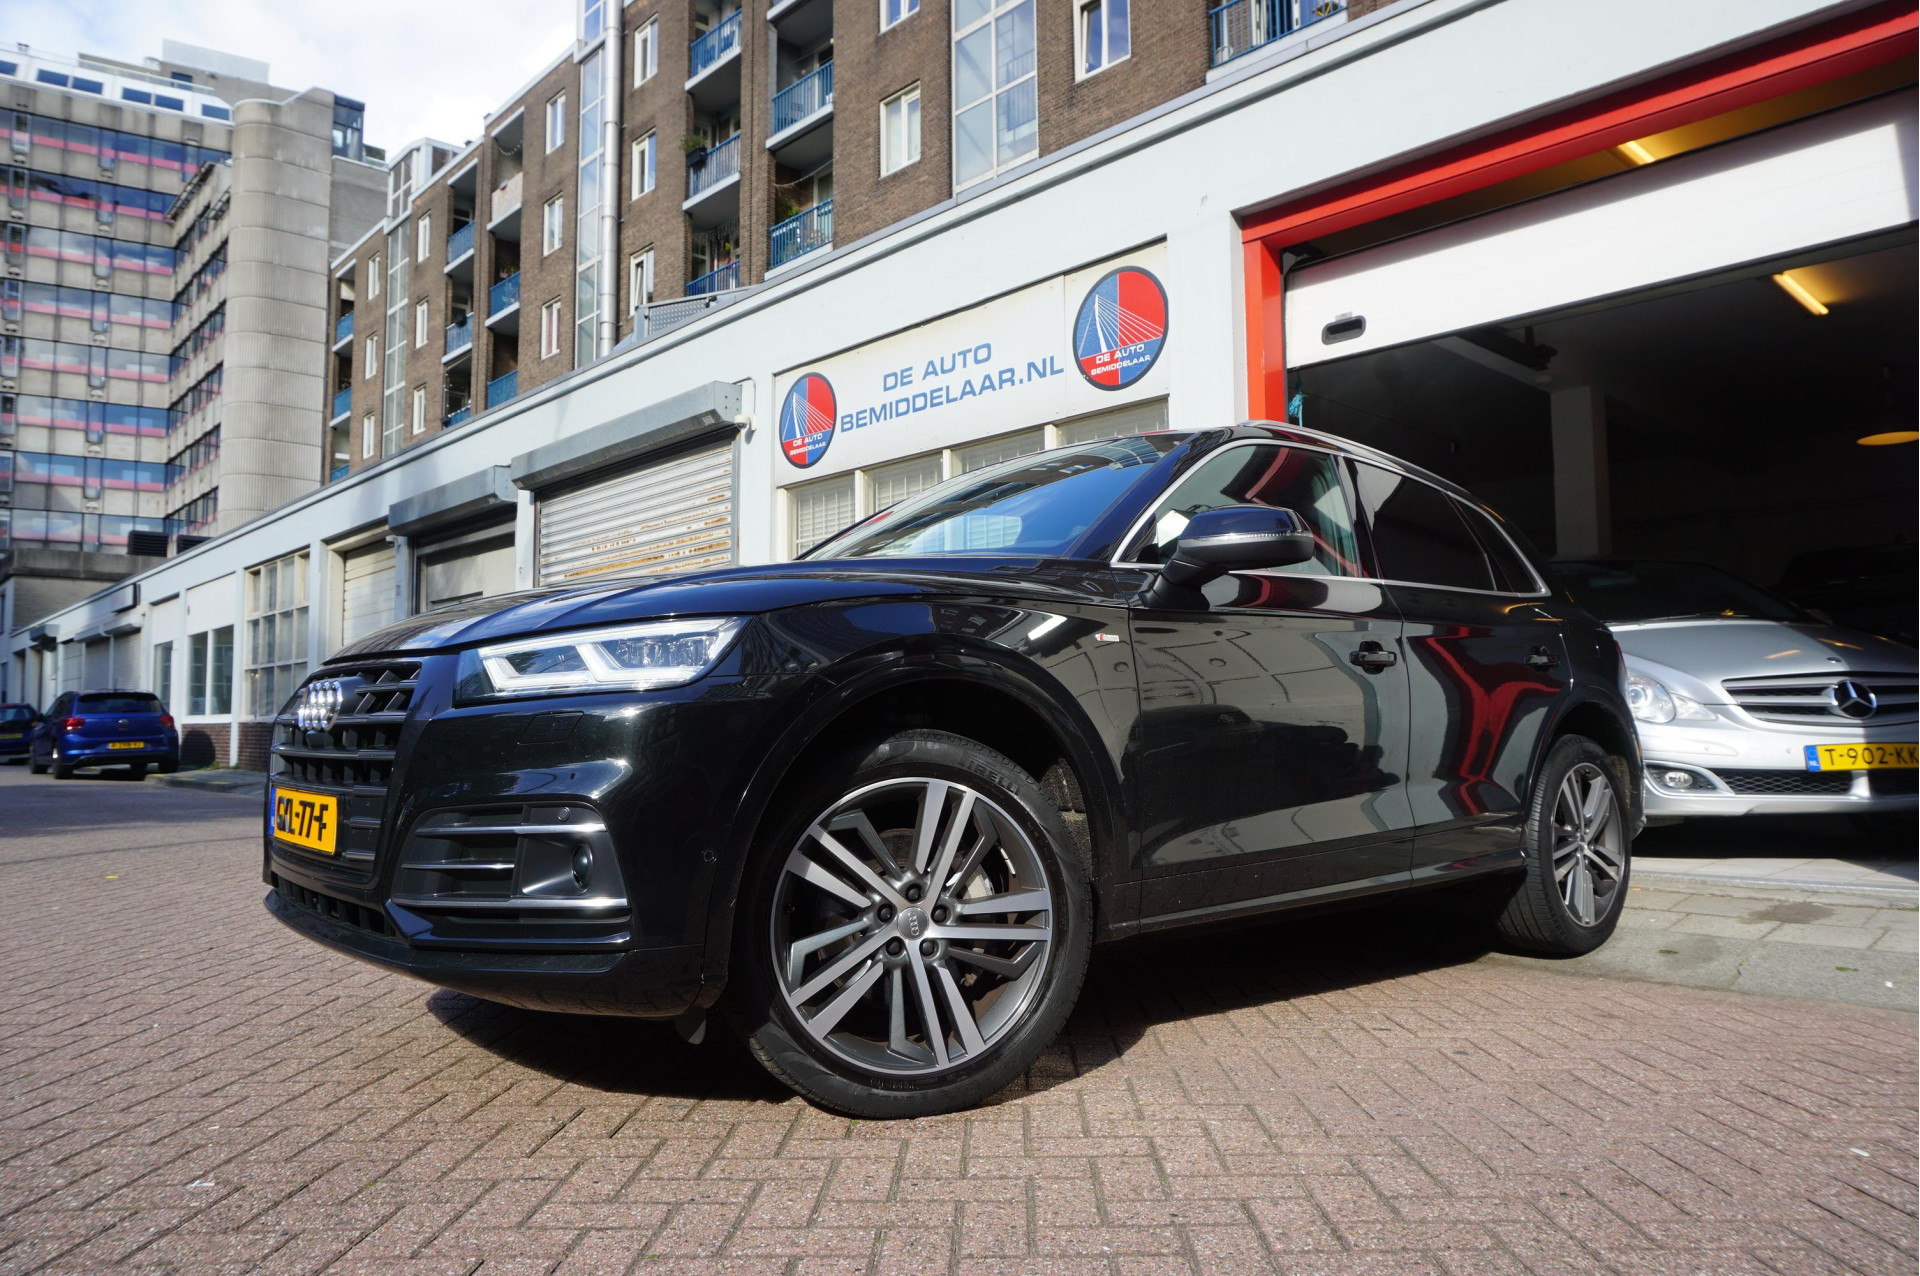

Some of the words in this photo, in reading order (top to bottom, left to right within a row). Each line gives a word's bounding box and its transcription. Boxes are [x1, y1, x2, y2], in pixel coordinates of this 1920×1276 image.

[1095, 353, 1111, 364] DE
[1113, 343, 1145, 360] AUTO
[883, 366, 913, 392] DE
[922, 343, 992, 381] AUTO
[1091, 354, 1150, 376] BEMIDDELAAR
[840, 355, 1064, 433] BEMIDDELAAR.NL
[790, 441, 827, 456] BEMIDDELAAR
[793, 438, 803, 447] DE
[804, 432, 823, 444] AUTO
